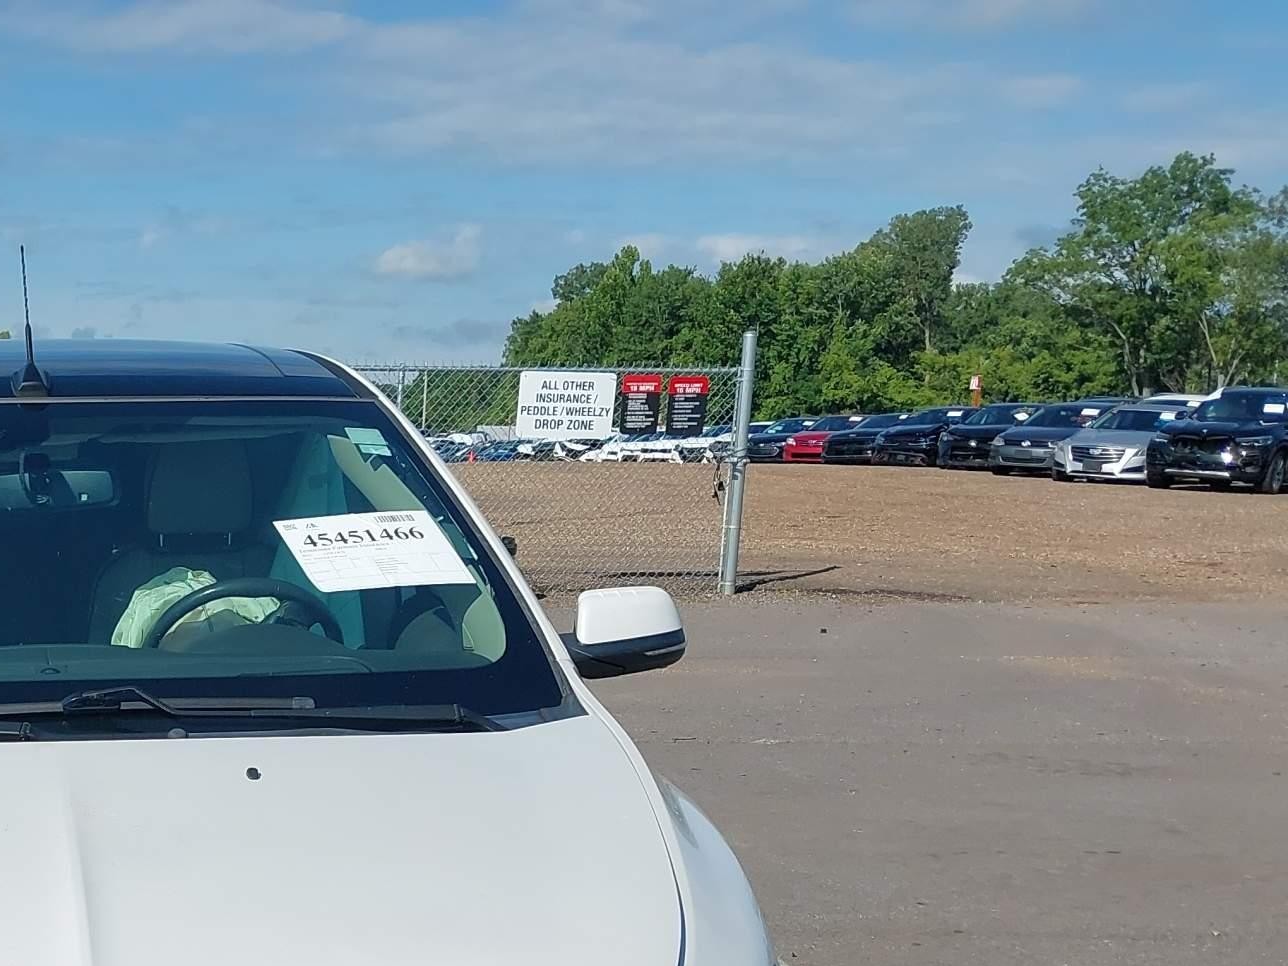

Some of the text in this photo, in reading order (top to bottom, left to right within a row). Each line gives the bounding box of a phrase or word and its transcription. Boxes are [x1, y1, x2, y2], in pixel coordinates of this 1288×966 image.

[541, 380, 595, 391] ALL OTHER
[535, 393, 593, 404] INSURANCE
[520, 405, 558, 416] PEDDLE
[565, 406, 611, 417] WHEELZY
[534, 419, 595, 431] DROP ZONE
[303, 526, 425, 547] 45451466
